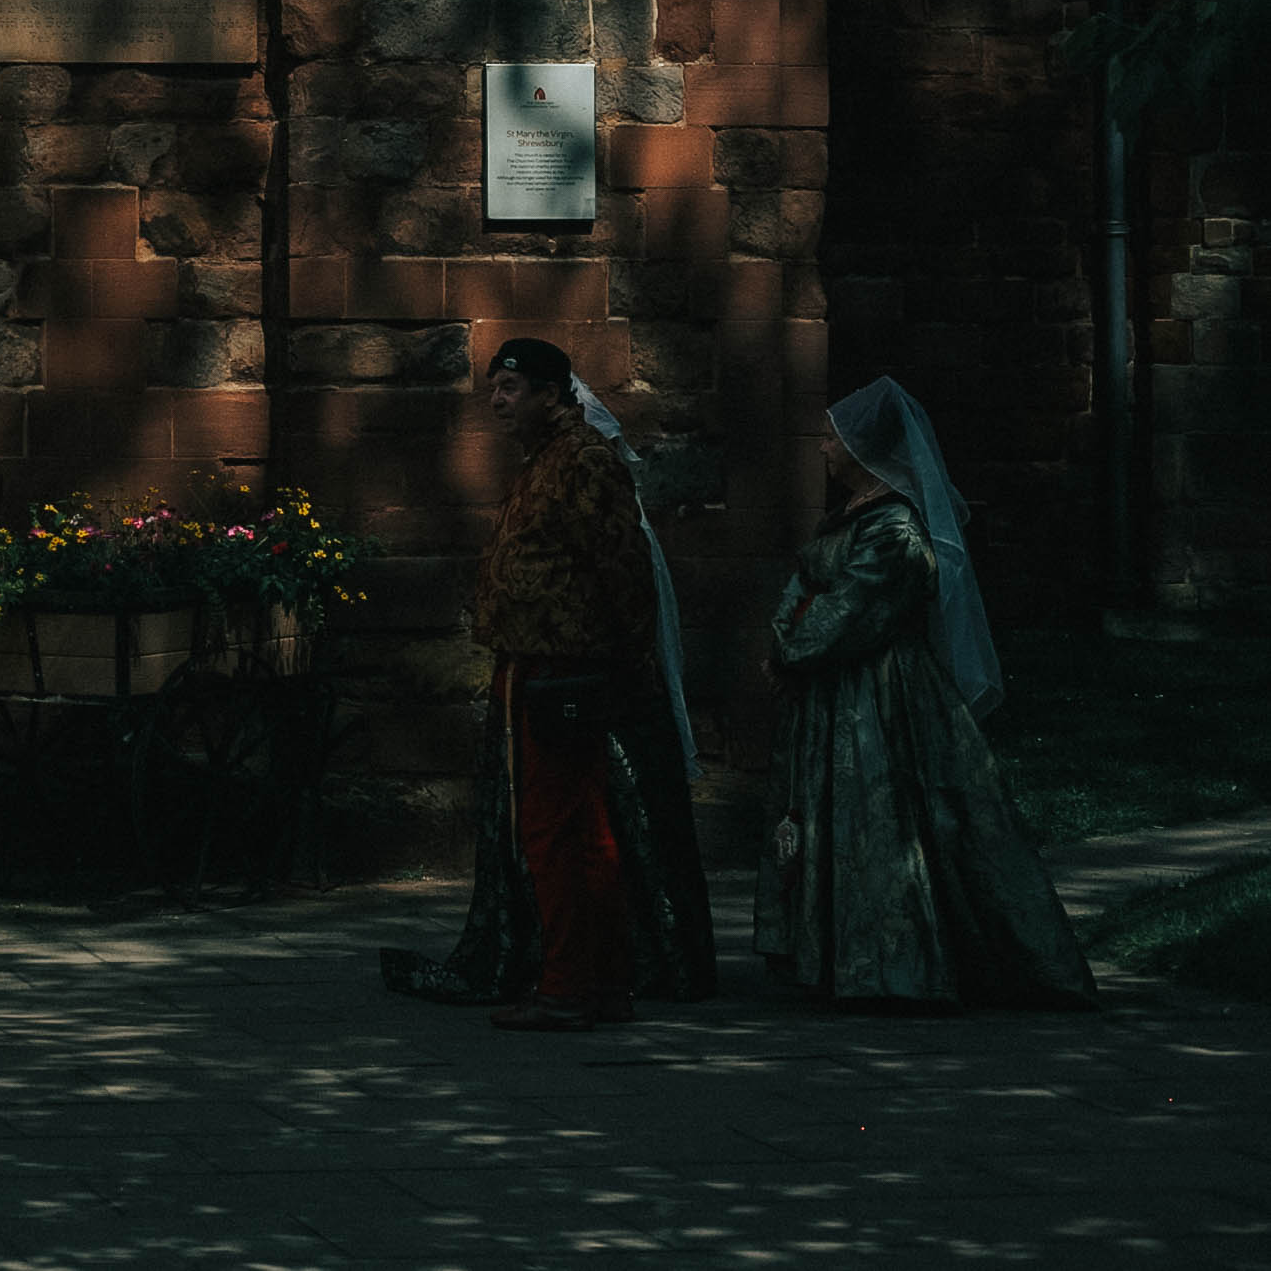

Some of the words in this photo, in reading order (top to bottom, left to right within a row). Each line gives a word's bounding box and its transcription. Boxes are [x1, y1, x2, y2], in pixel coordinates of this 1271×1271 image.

[506, 129, 515, 138] St
[516, 129, 535, 140] Mary
[536, 129, 550, 138] the
[517, 138, 564, 149] Shrewsbury
